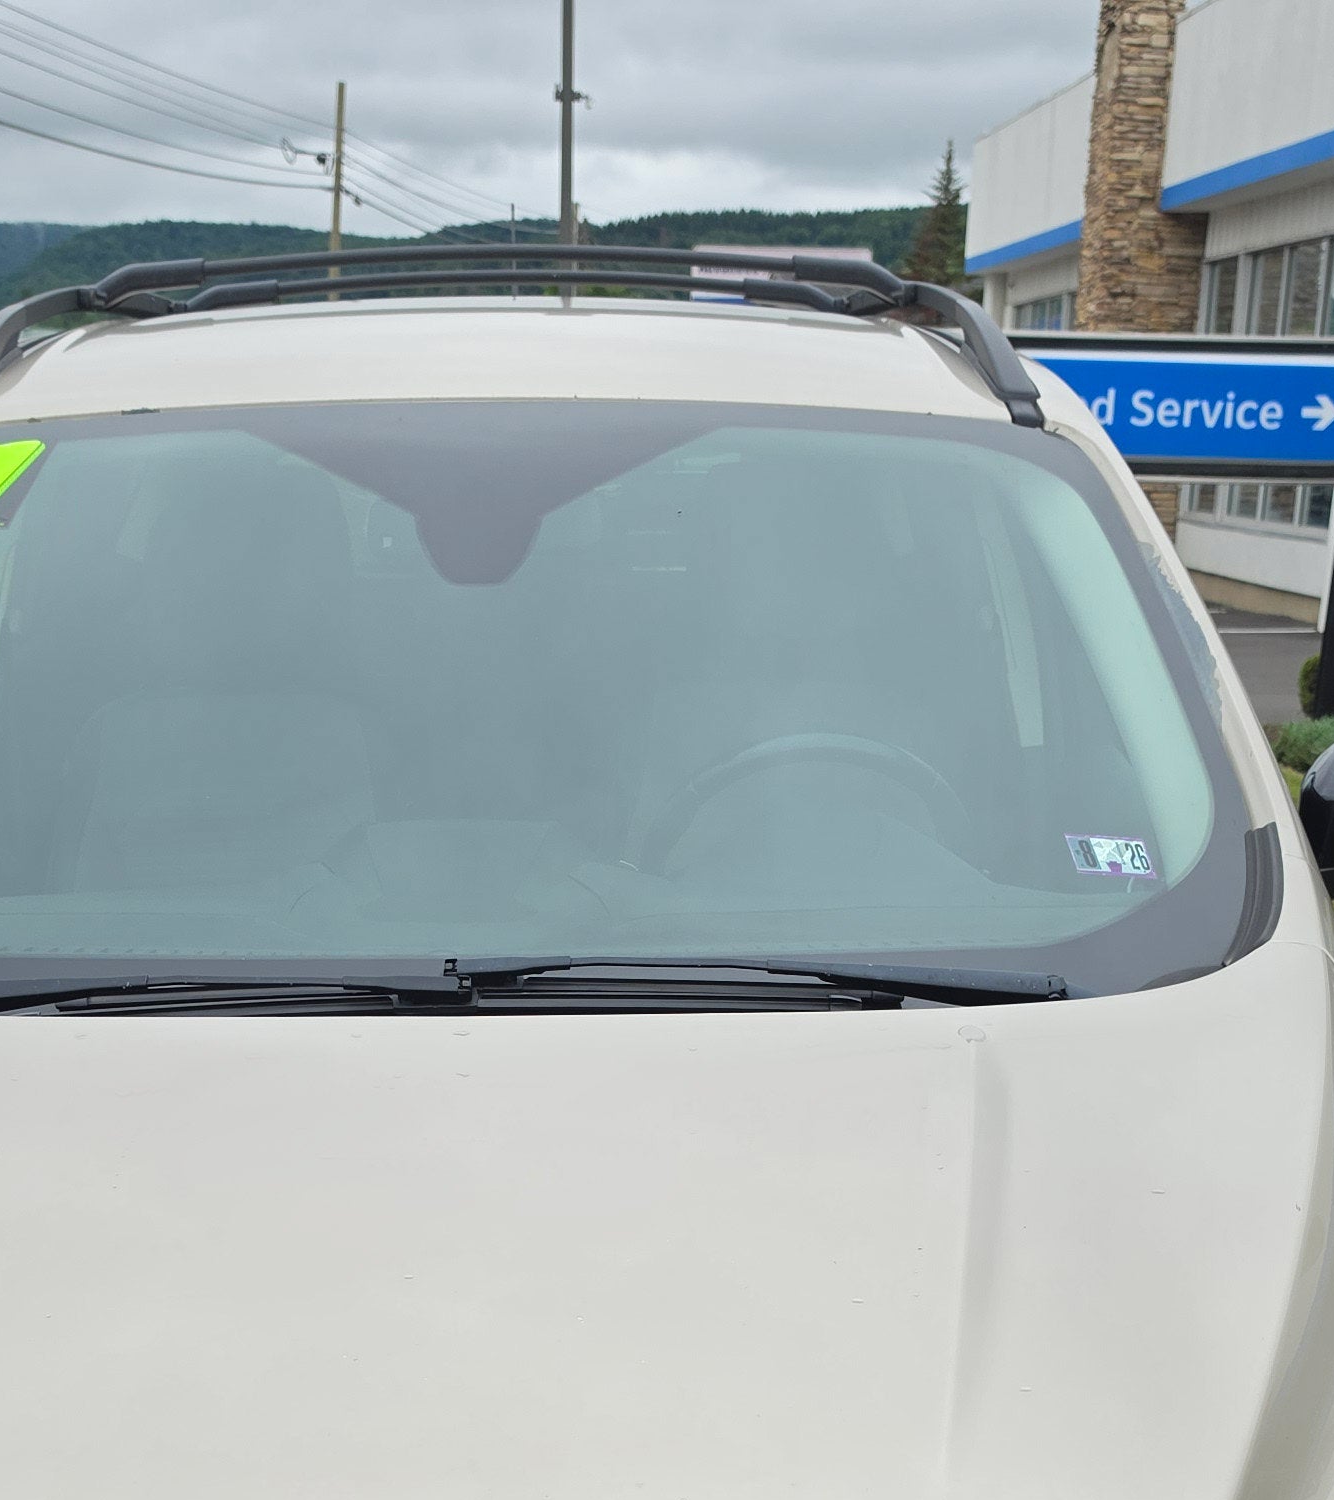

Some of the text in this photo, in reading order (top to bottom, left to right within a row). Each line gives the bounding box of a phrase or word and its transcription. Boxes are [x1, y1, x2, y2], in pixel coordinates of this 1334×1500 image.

[1082, 387, 1284, 431] d Service
[1125, 842, 1151, 871] 26
